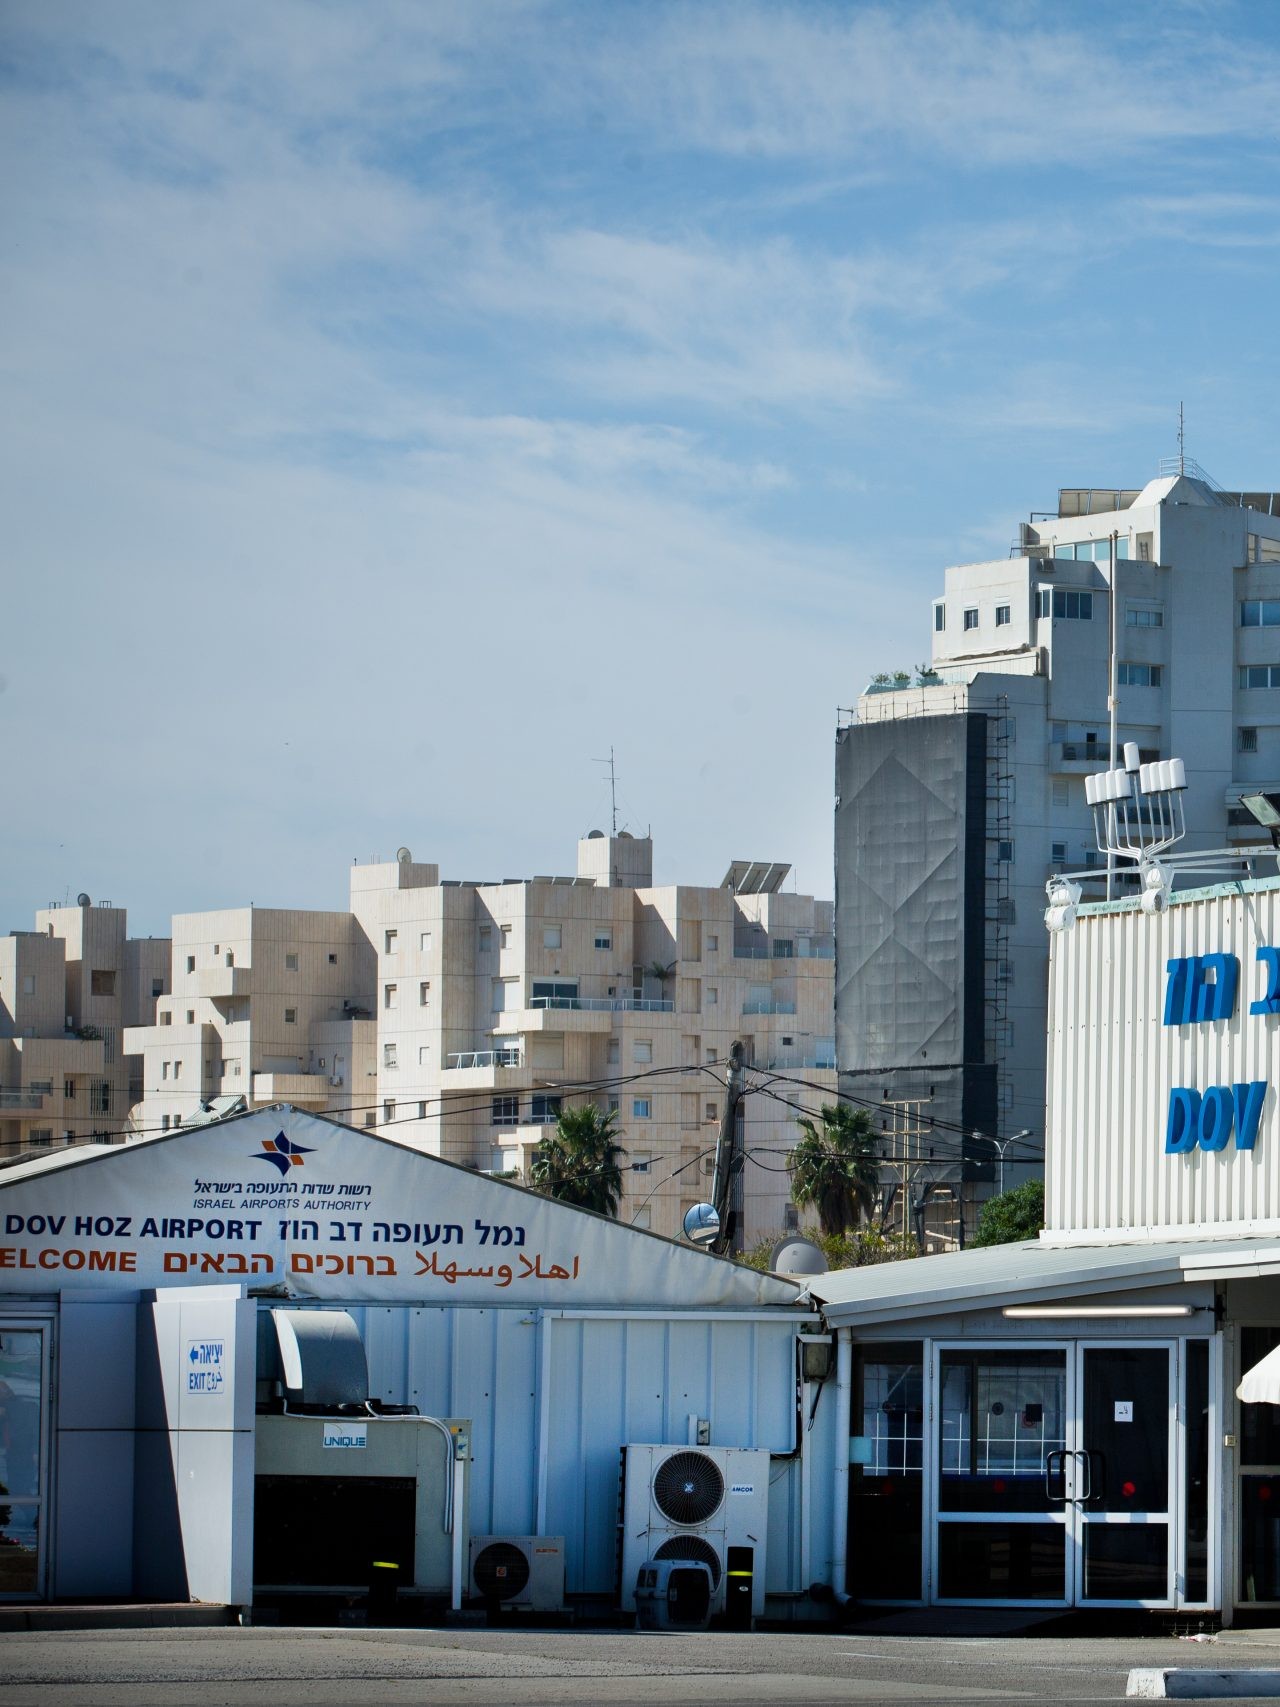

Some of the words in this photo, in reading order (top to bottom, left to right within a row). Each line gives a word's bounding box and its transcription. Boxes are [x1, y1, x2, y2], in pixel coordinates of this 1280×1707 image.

[1164, 953, 1237, 1026] הוז
[1165, 1081, 1268, 1154] DOV
[194, 1178, 243, 1194] בישראל
[246, 1182, 298, 1195] התעופה
[301, 1183, 335, 1195] שדות
[337, 1183, 372, 1196] רשות
[193, 1198, 235, 1209] ISRAEL
[240, 1198, 300, 1209] AIRPORTS
[303, 1200, 372, 1211] AUTHORITY
[5, 1214, 67, 1235] DOV
[74, 1216, 132, 1237] HOZ
[139, 1218, 262, 1240] AIRPORT
[329, 1221, 363, 1241] דב
[372, 1221, 464, 1246] תעופה
[474, 1219, 526, 1246] נמל
[0, 1247, 137, 1272] ELCOME
[163, 1252, 274, 1273] הבאים
[291, 1253, 397, 1276] ברוכים
[200, 1344, 223, 1364] יציאה
[189, 1372, 206, 1390] EXIT
[324, 1436, 366, 1447] UNIQUE
